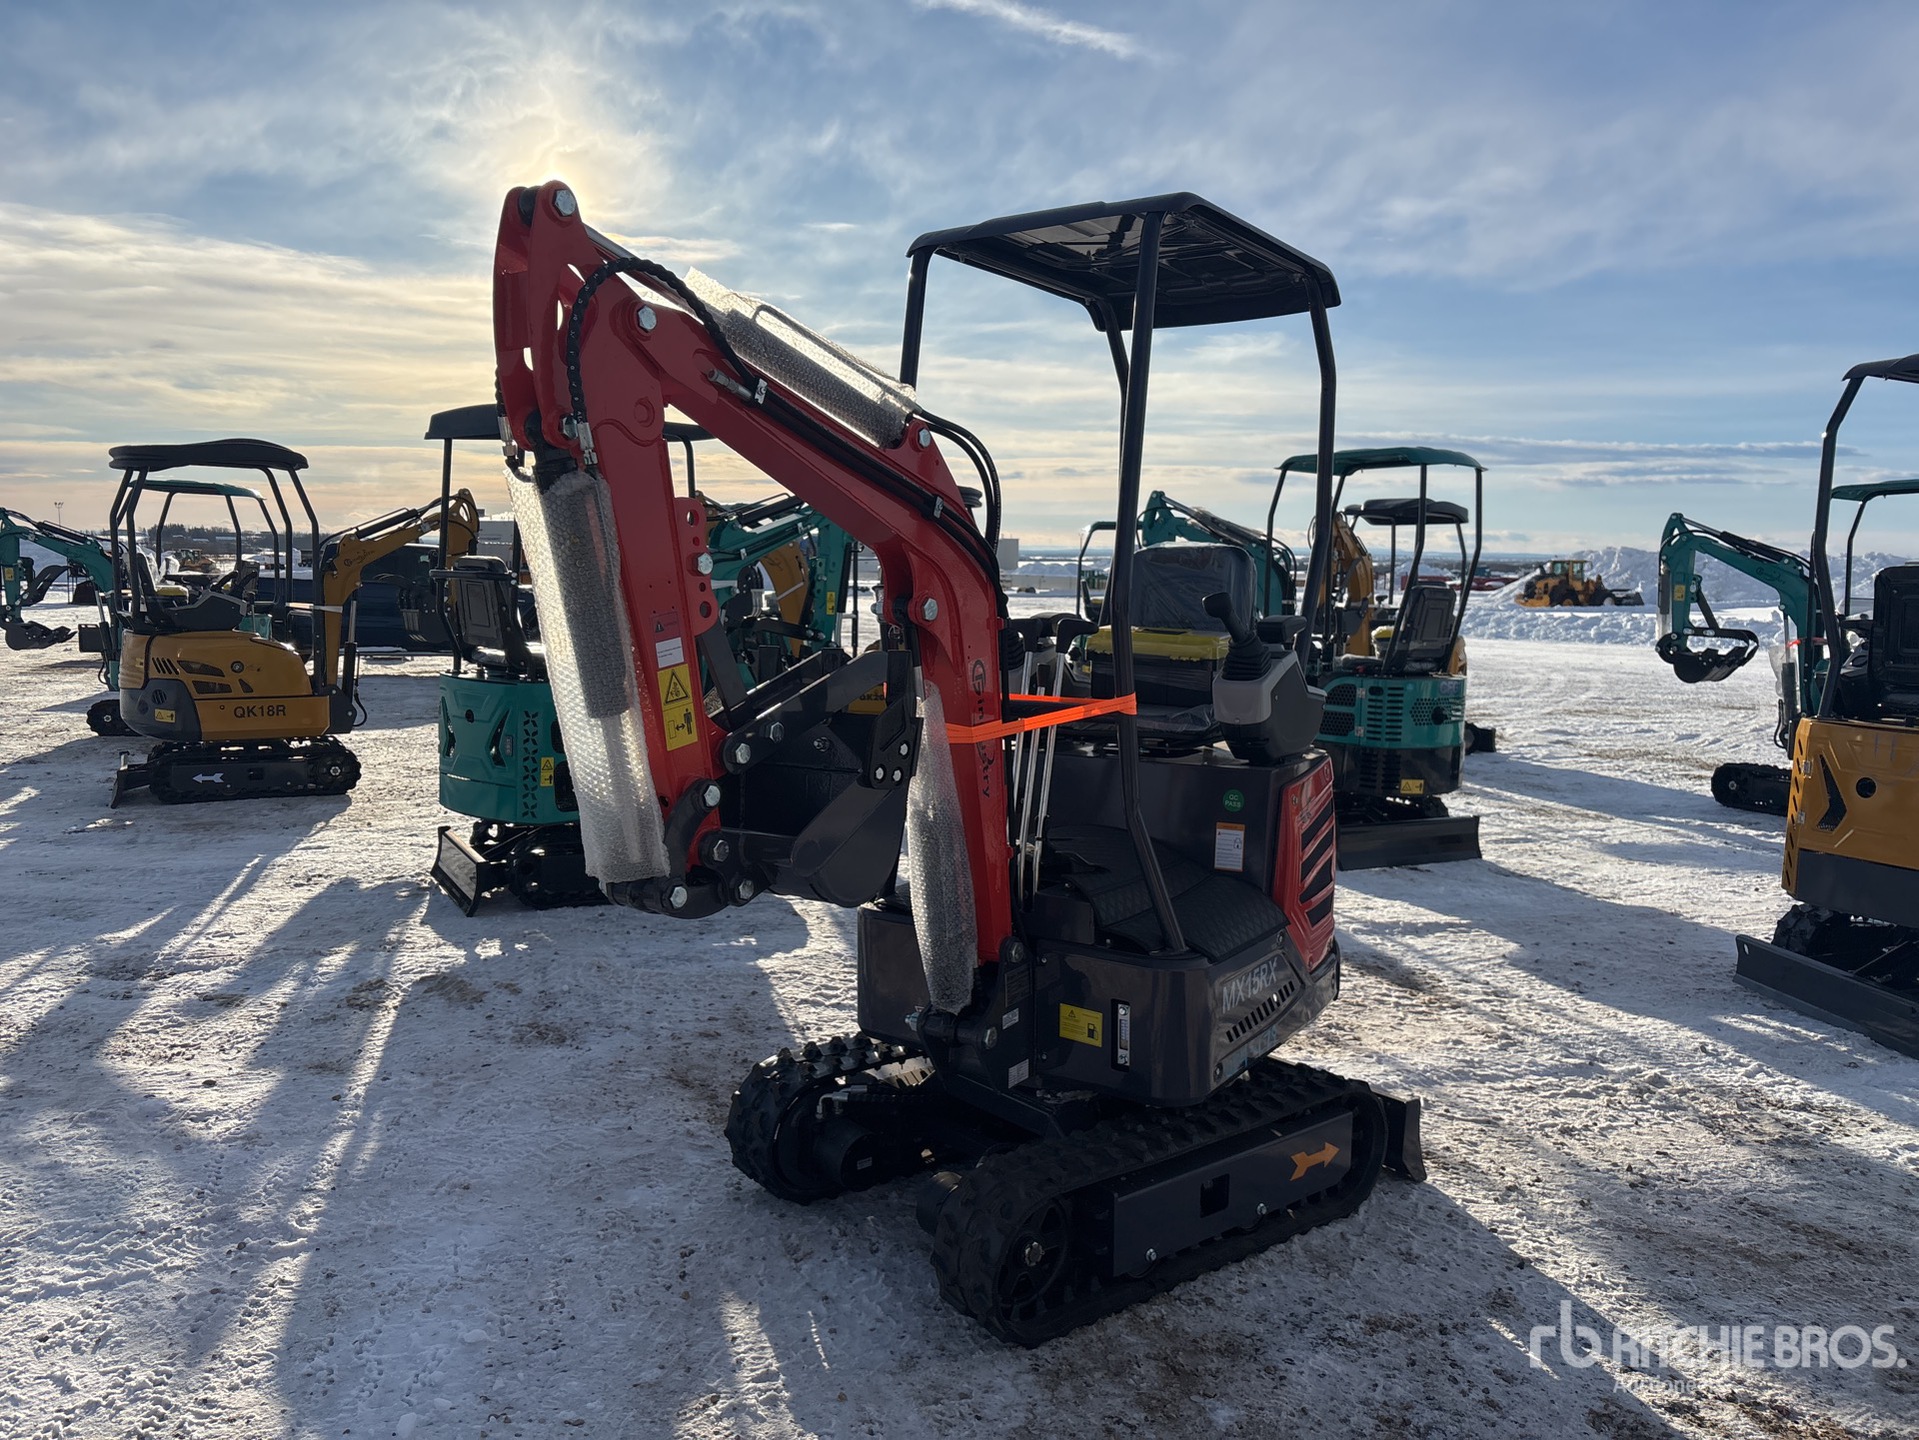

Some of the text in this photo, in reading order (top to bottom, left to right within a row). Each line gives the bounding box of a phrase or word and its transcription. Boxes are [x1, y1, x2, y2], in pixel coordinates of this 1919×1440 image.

[233, 704, 287, 719] QK18R
[1224, 801, 1241, 809] PASS
[1222, 957, 1278, 1014] MX15RX
